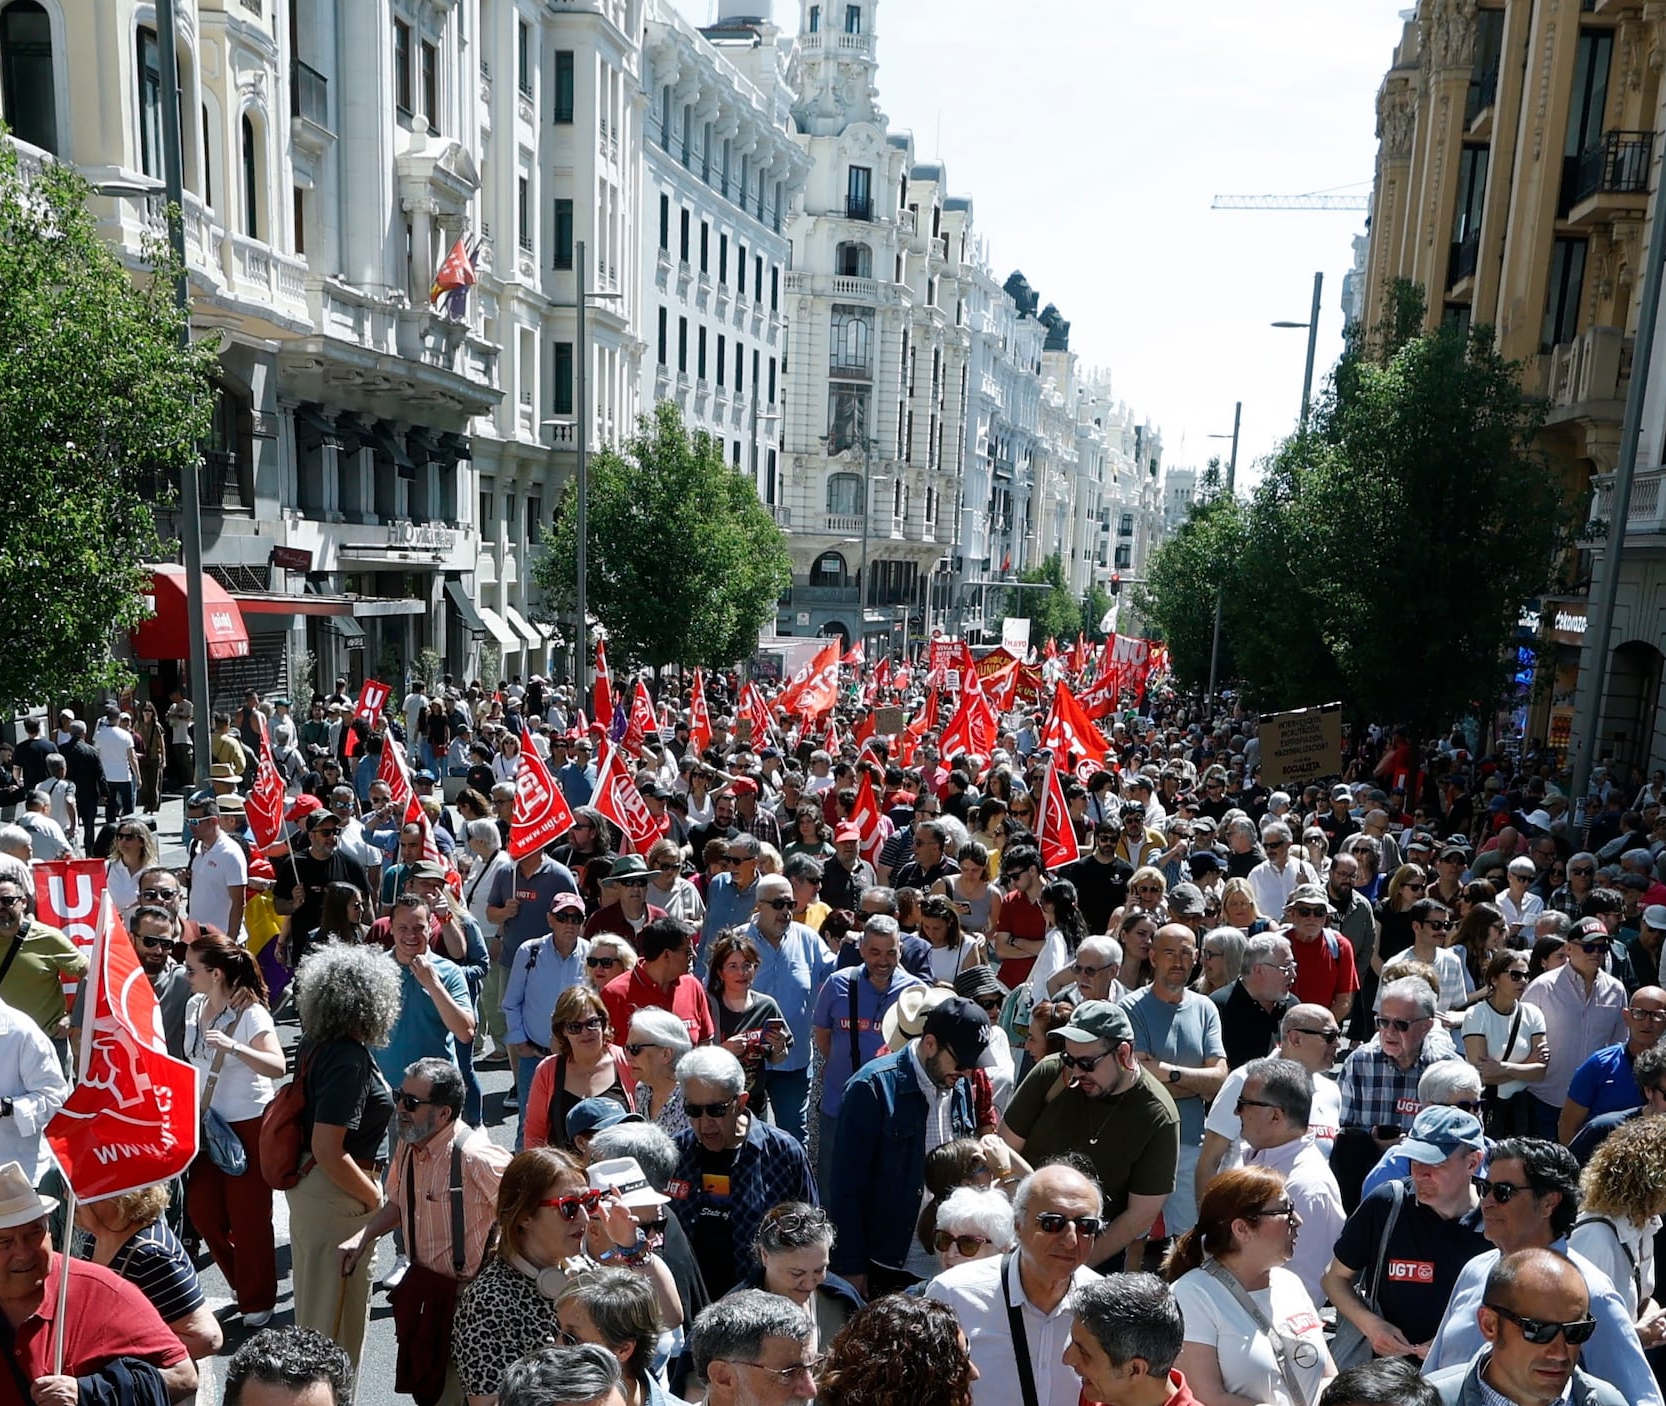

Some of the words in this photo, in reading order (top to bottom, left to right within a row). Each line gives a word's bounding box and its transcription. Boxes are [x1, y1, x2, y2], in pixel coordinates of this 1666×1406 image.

[1112, 637, 1148, 666] NO
[1583, 922, 1600, 932] UGT
[1397, 1100, 1421, 1112] UGT
[701, 1207, 720, 1218] State
[1389, 1263, 1416, 1278] UGT
